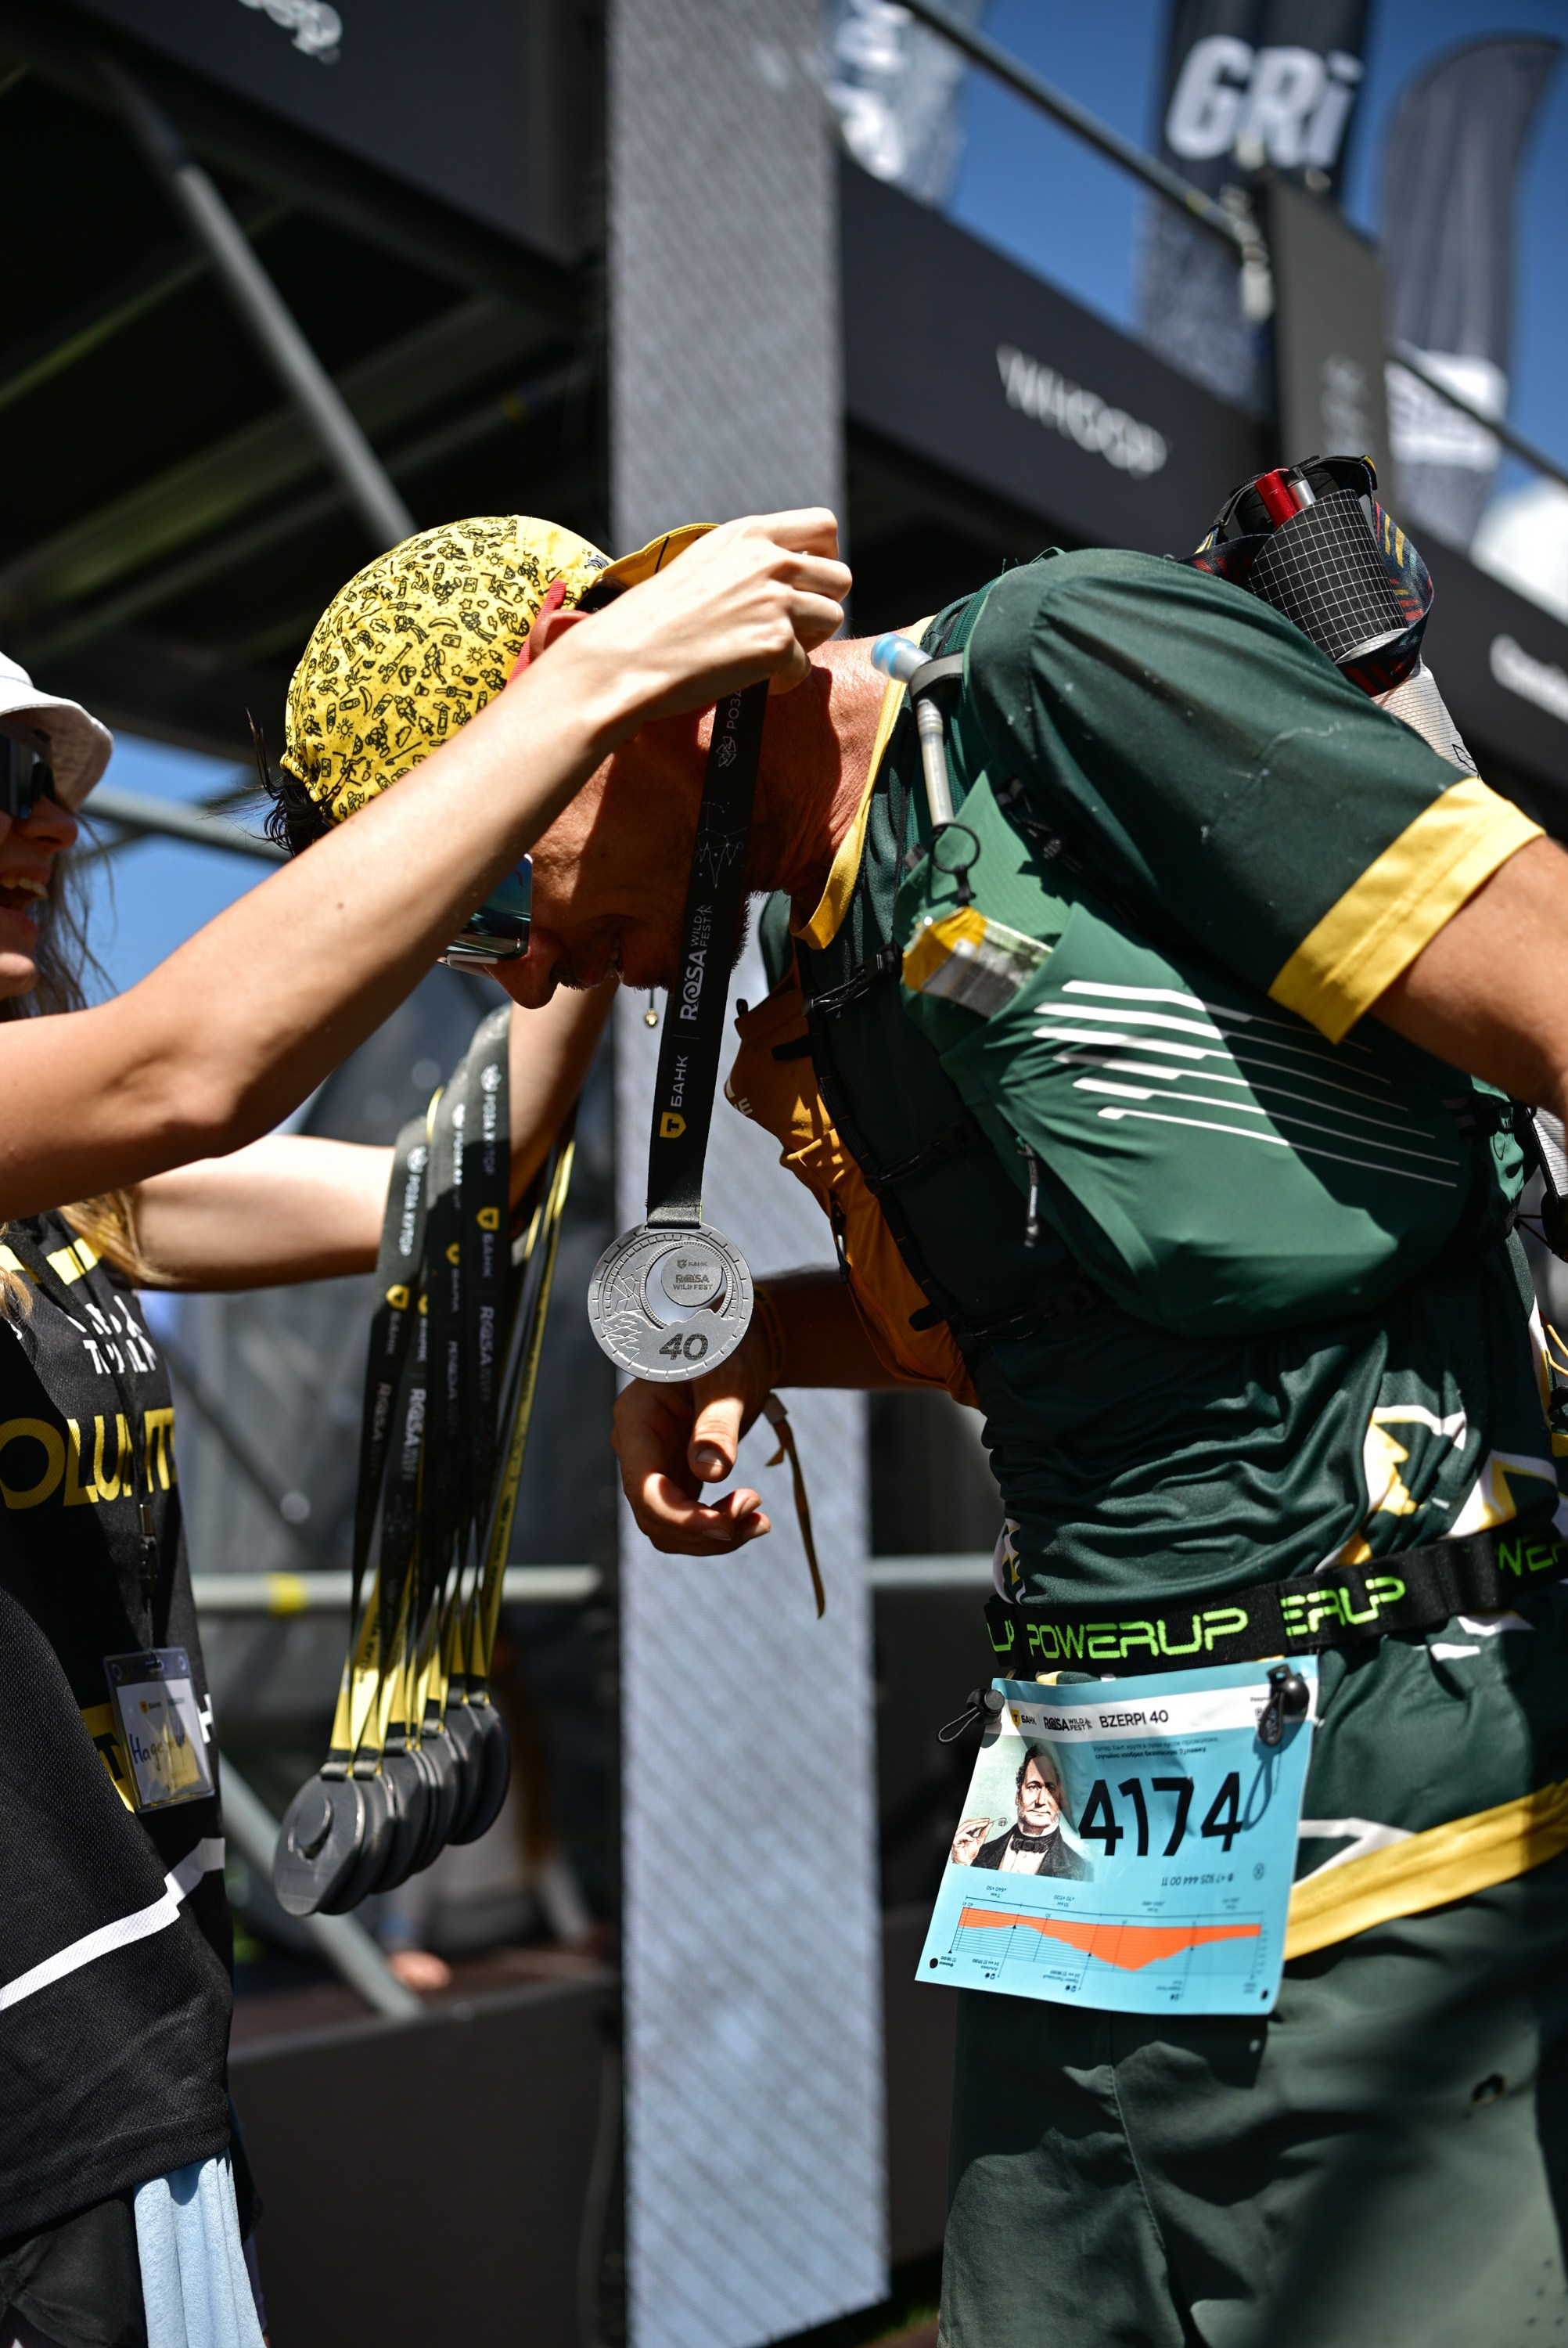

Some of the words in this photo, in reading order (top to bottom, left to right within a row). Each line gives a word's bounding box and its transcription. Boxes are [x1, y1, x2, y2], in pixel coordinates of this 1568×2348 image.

[690, 915, 703, 947] WILD
[699, 917, 713, 948] FEST
[671, 1054, 689, 1107] БАНК
[660, 1332, 709, 1361] 40
[1026, 1607, 1248, 1659] POWERUP
[1020, 1715, 1038, 1726] БАНК
[1099, 1712, 1147, 1728] BZERPI
[1149, 1709, 1169, 1723] 40
[1078, 1771, 1243, 1856] 4174
[1170, 1875, 1181, 1886] 00
